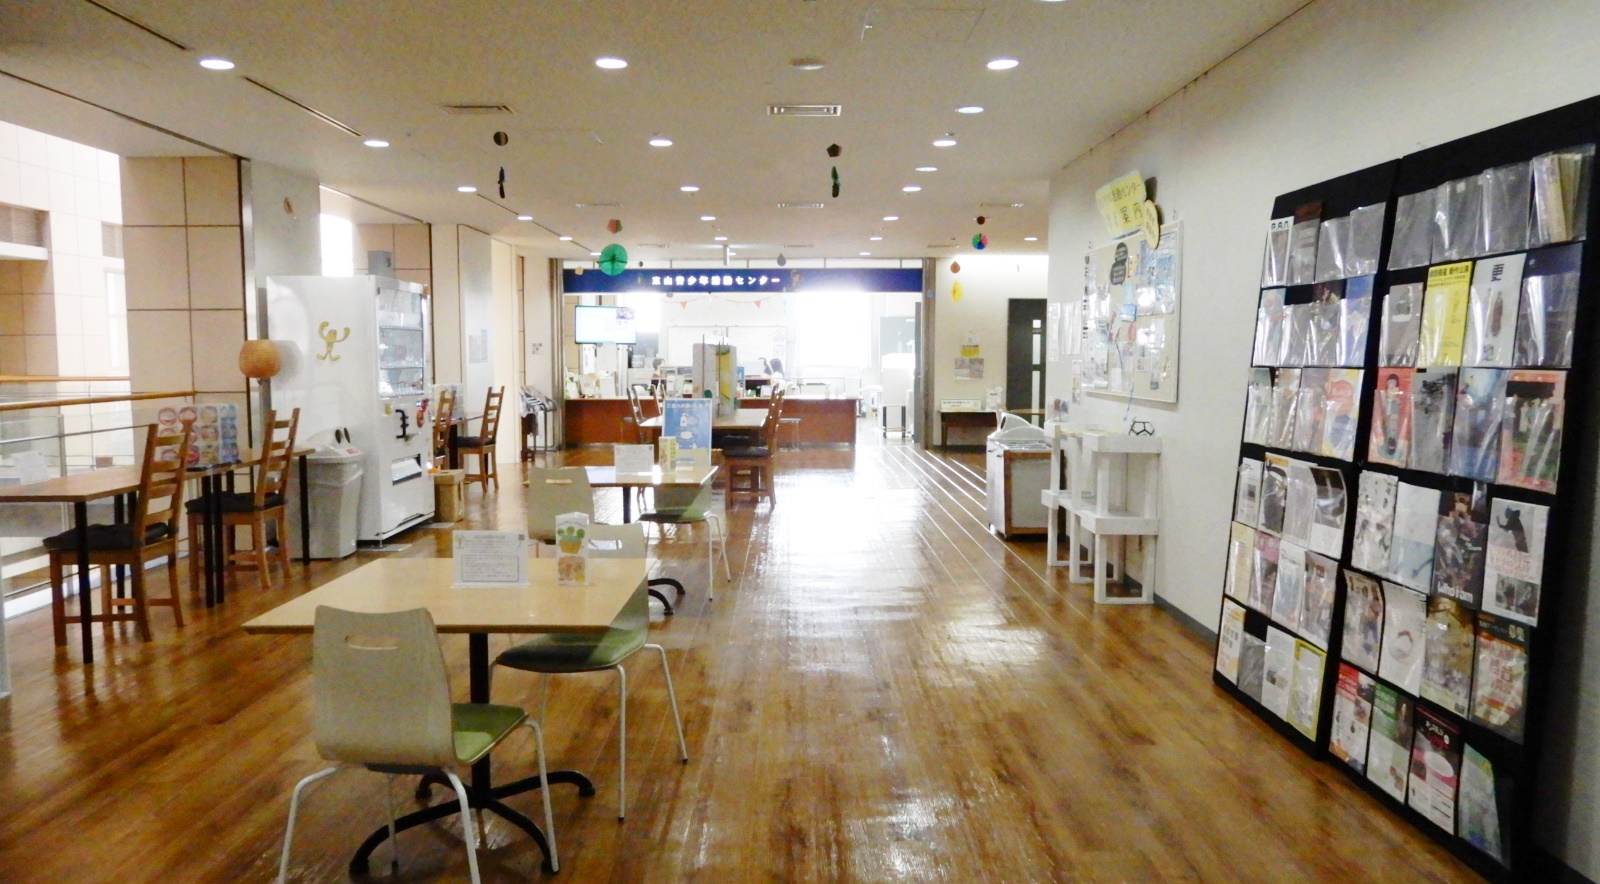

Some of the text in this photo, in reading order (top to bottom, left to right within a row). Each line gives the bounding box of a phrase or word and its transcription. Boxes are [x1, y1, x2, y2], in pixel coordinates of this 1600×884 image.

[651, 275, 781, 286] 東山青少年活動センター
